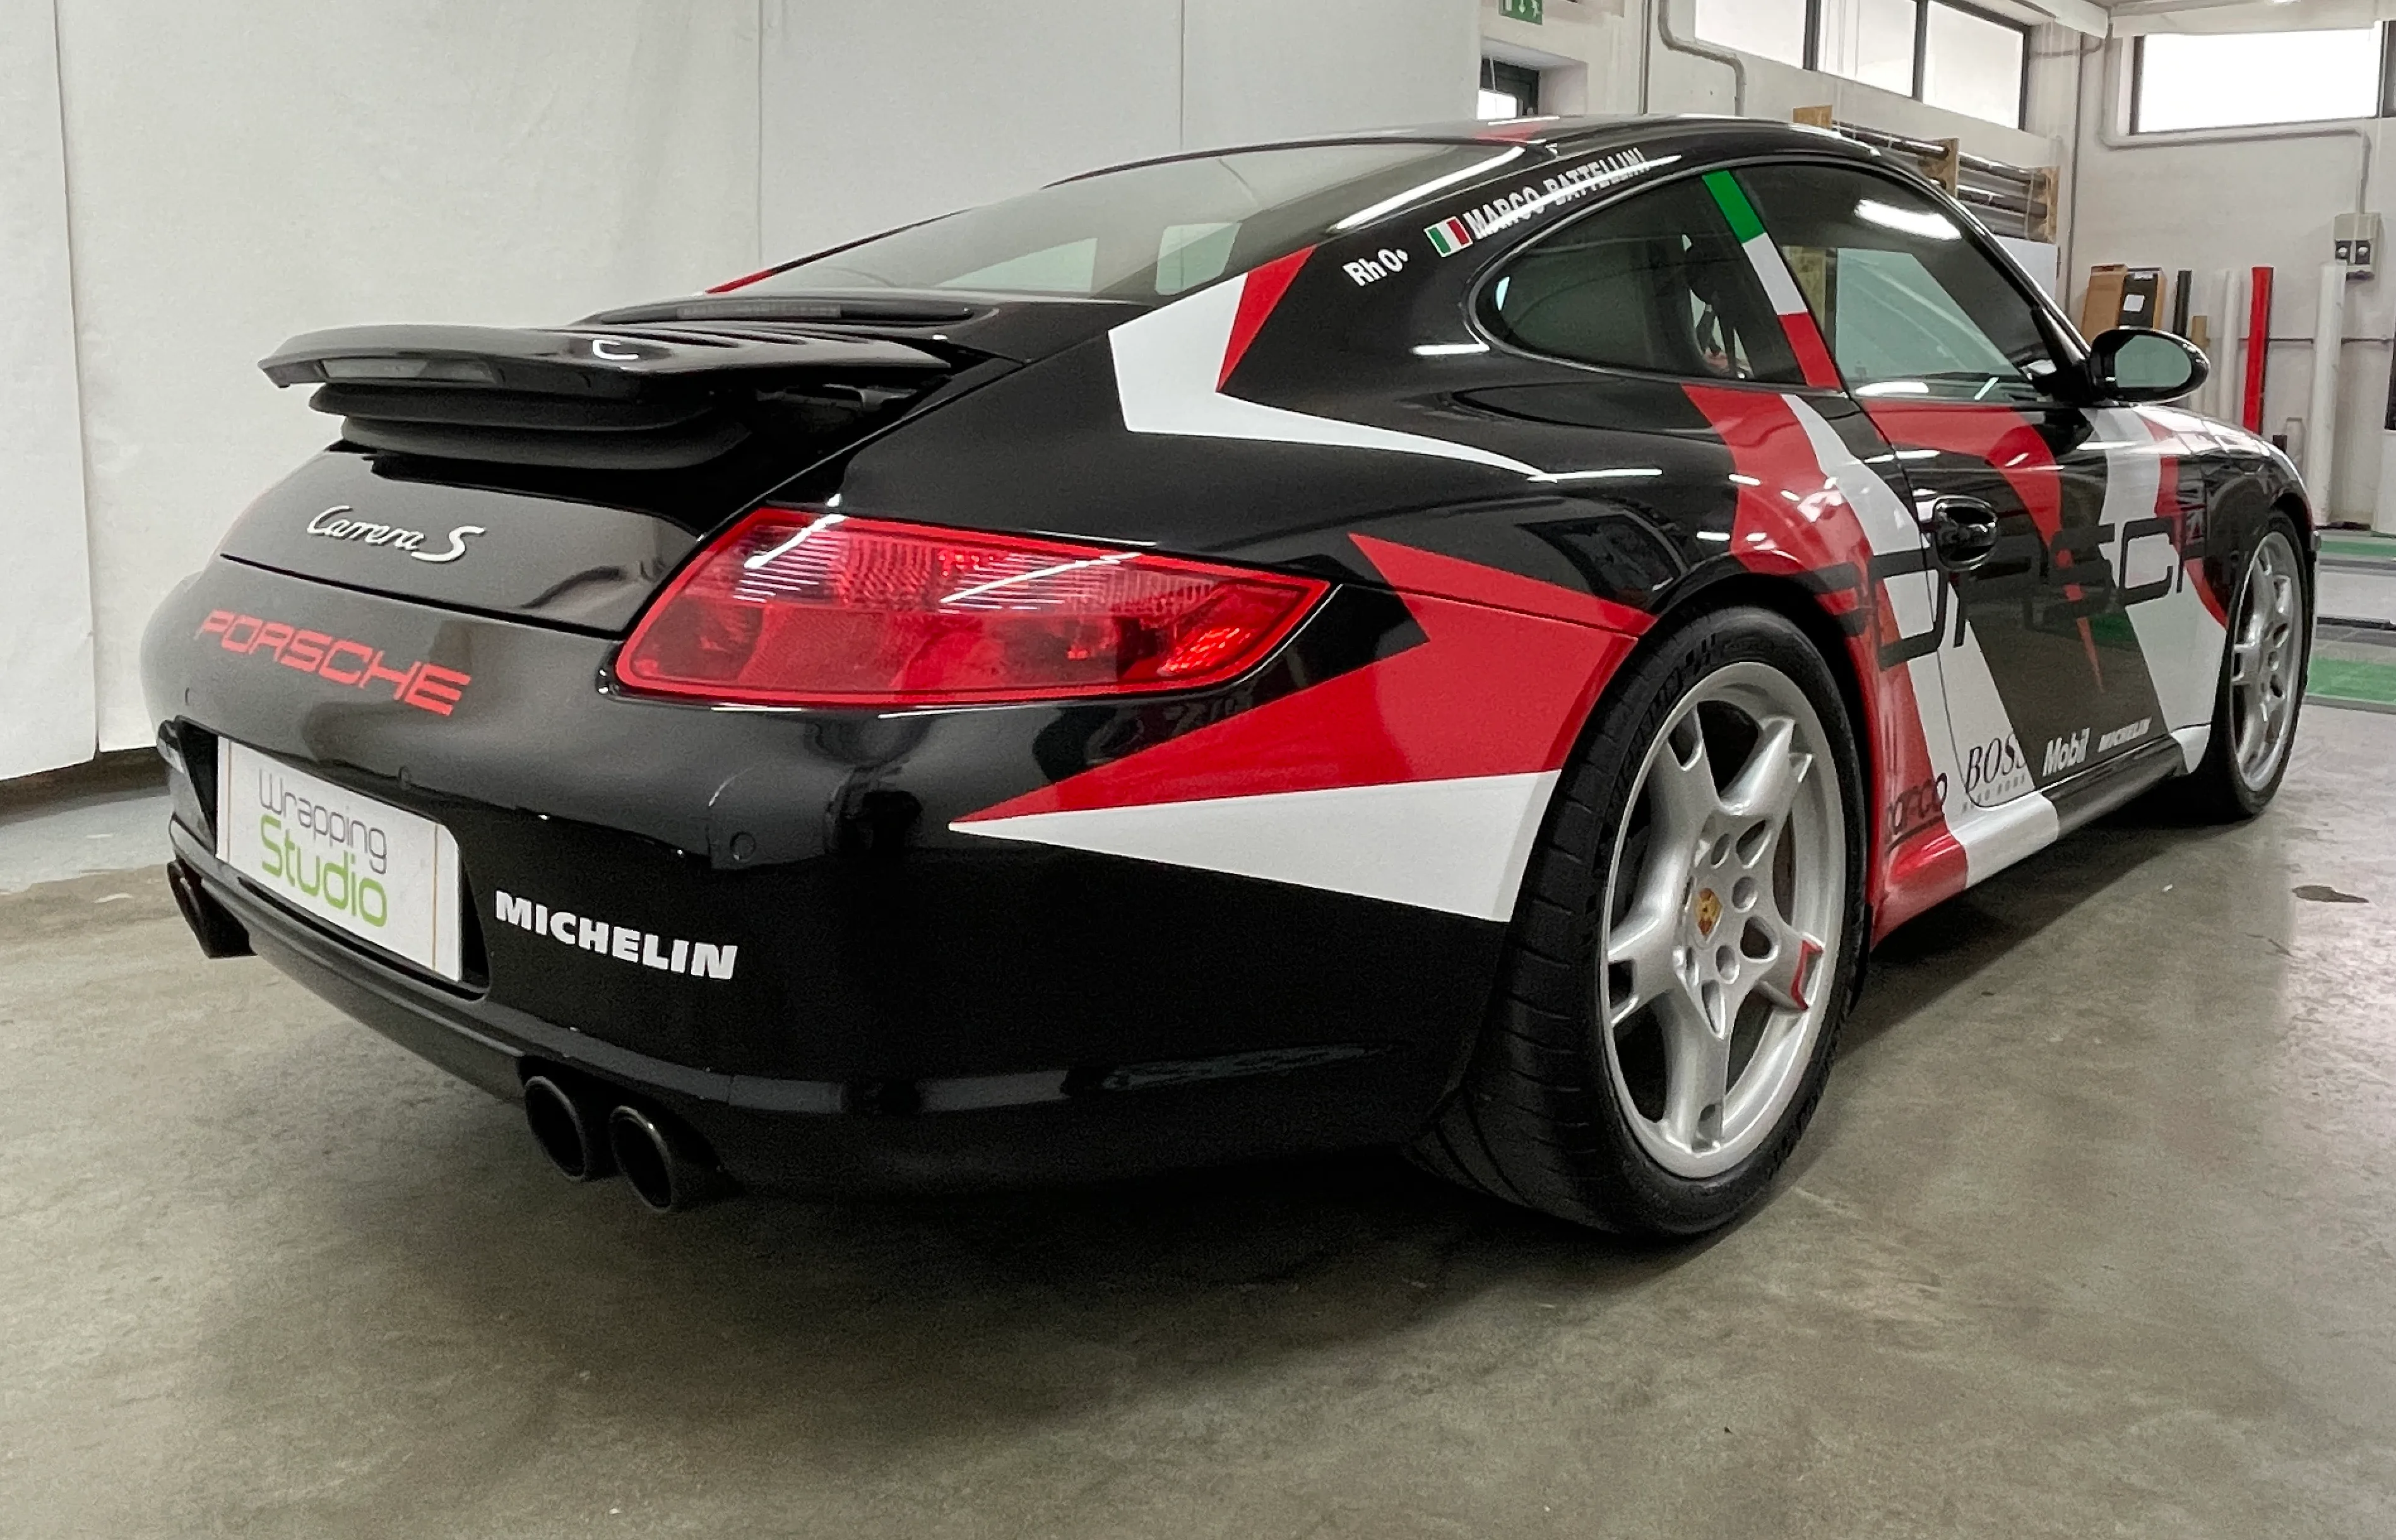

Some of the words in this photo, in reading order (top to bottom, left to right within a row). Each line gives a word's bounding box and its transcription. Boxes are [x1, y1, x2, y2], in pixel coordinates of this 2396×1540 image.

[1463, 187, 1546, 240] MARCO
[1343, 258, 1387, 287] Rh
[307, 505, 425, 551] Carrera
[411, 525, 486, 563] S
[194, 609, 472, 716] PORSCHE
[2043, 727, 2091, 778] Mobil
[258, 766, 388, 875] Wrapping
[259, 814, 388, 928] Studio
[494, 890, 738, 980] MICHELIN
